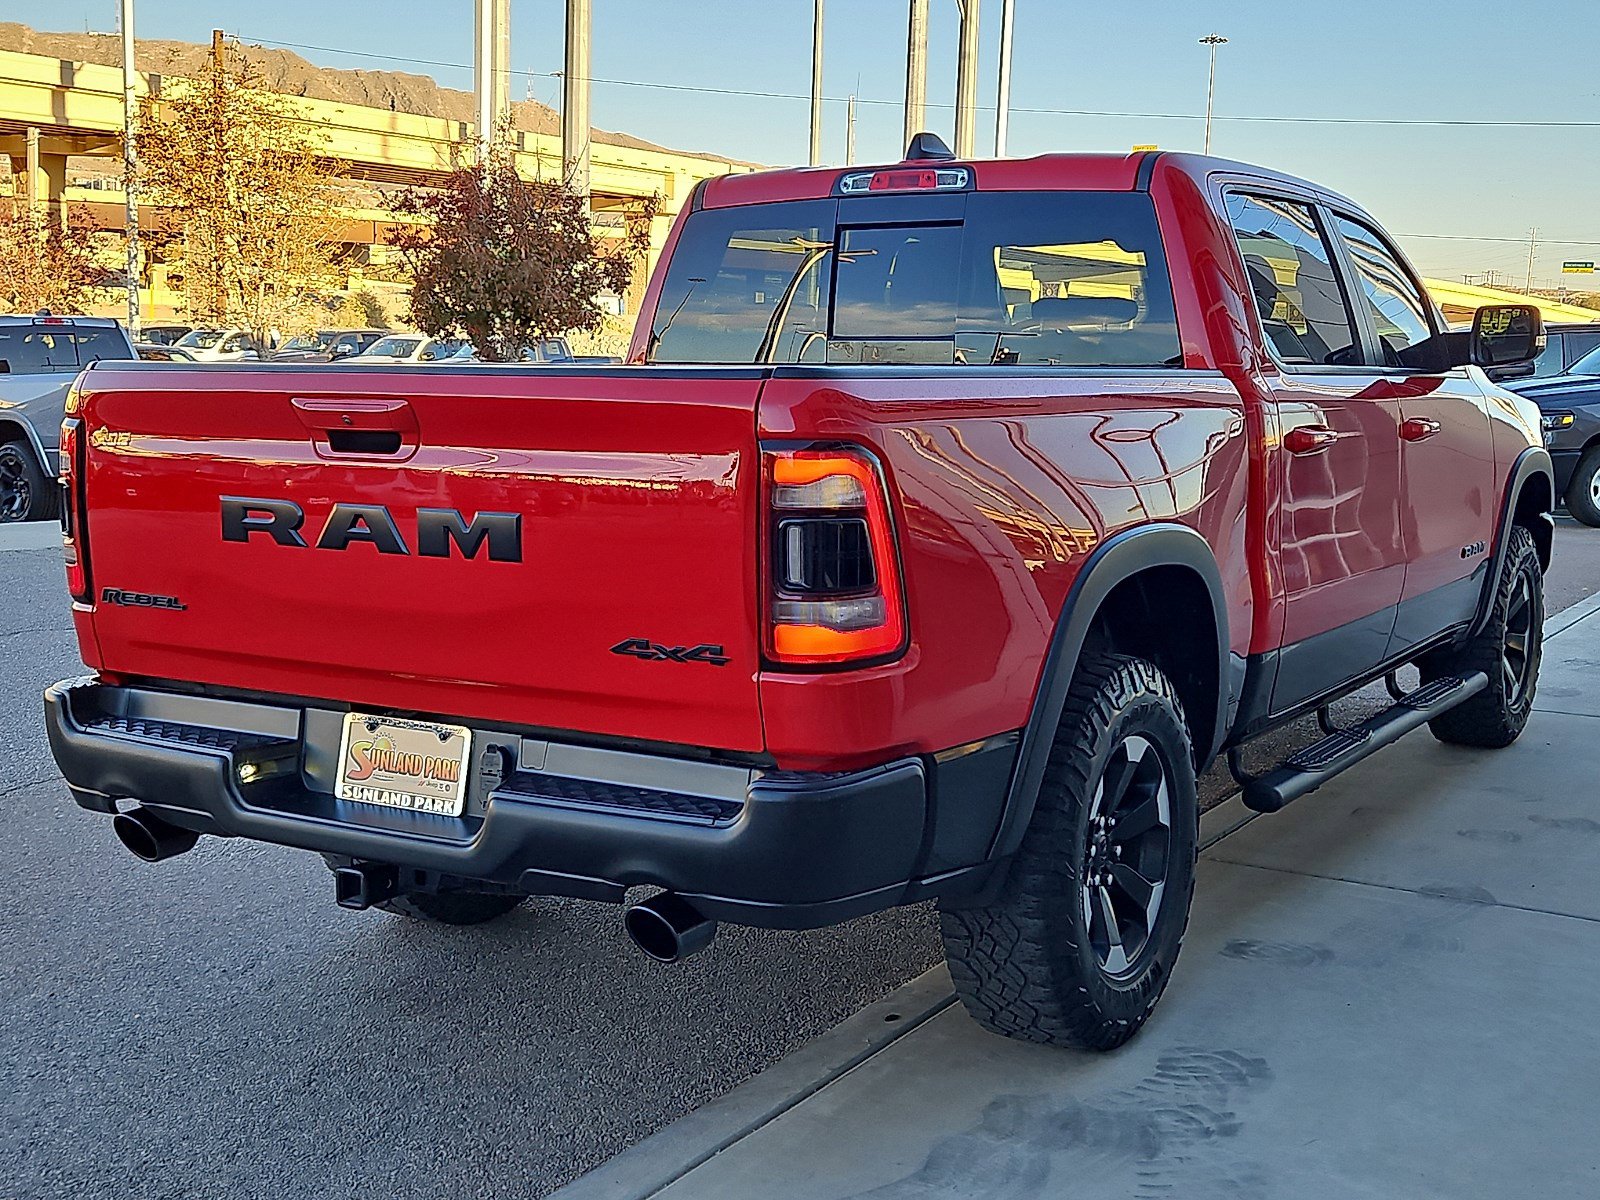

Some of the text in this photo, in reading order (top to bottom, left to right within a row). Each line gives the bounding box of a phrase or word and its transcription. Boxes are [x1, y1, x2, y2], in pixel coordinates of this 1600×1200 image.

[219, 494, 523, 563] RAM
[101, 587, 188, 611] REBEL
[346, 741, 461, 783] SUNLAND PARK
[342, 785, 454, 814] SUNLAND PARK
